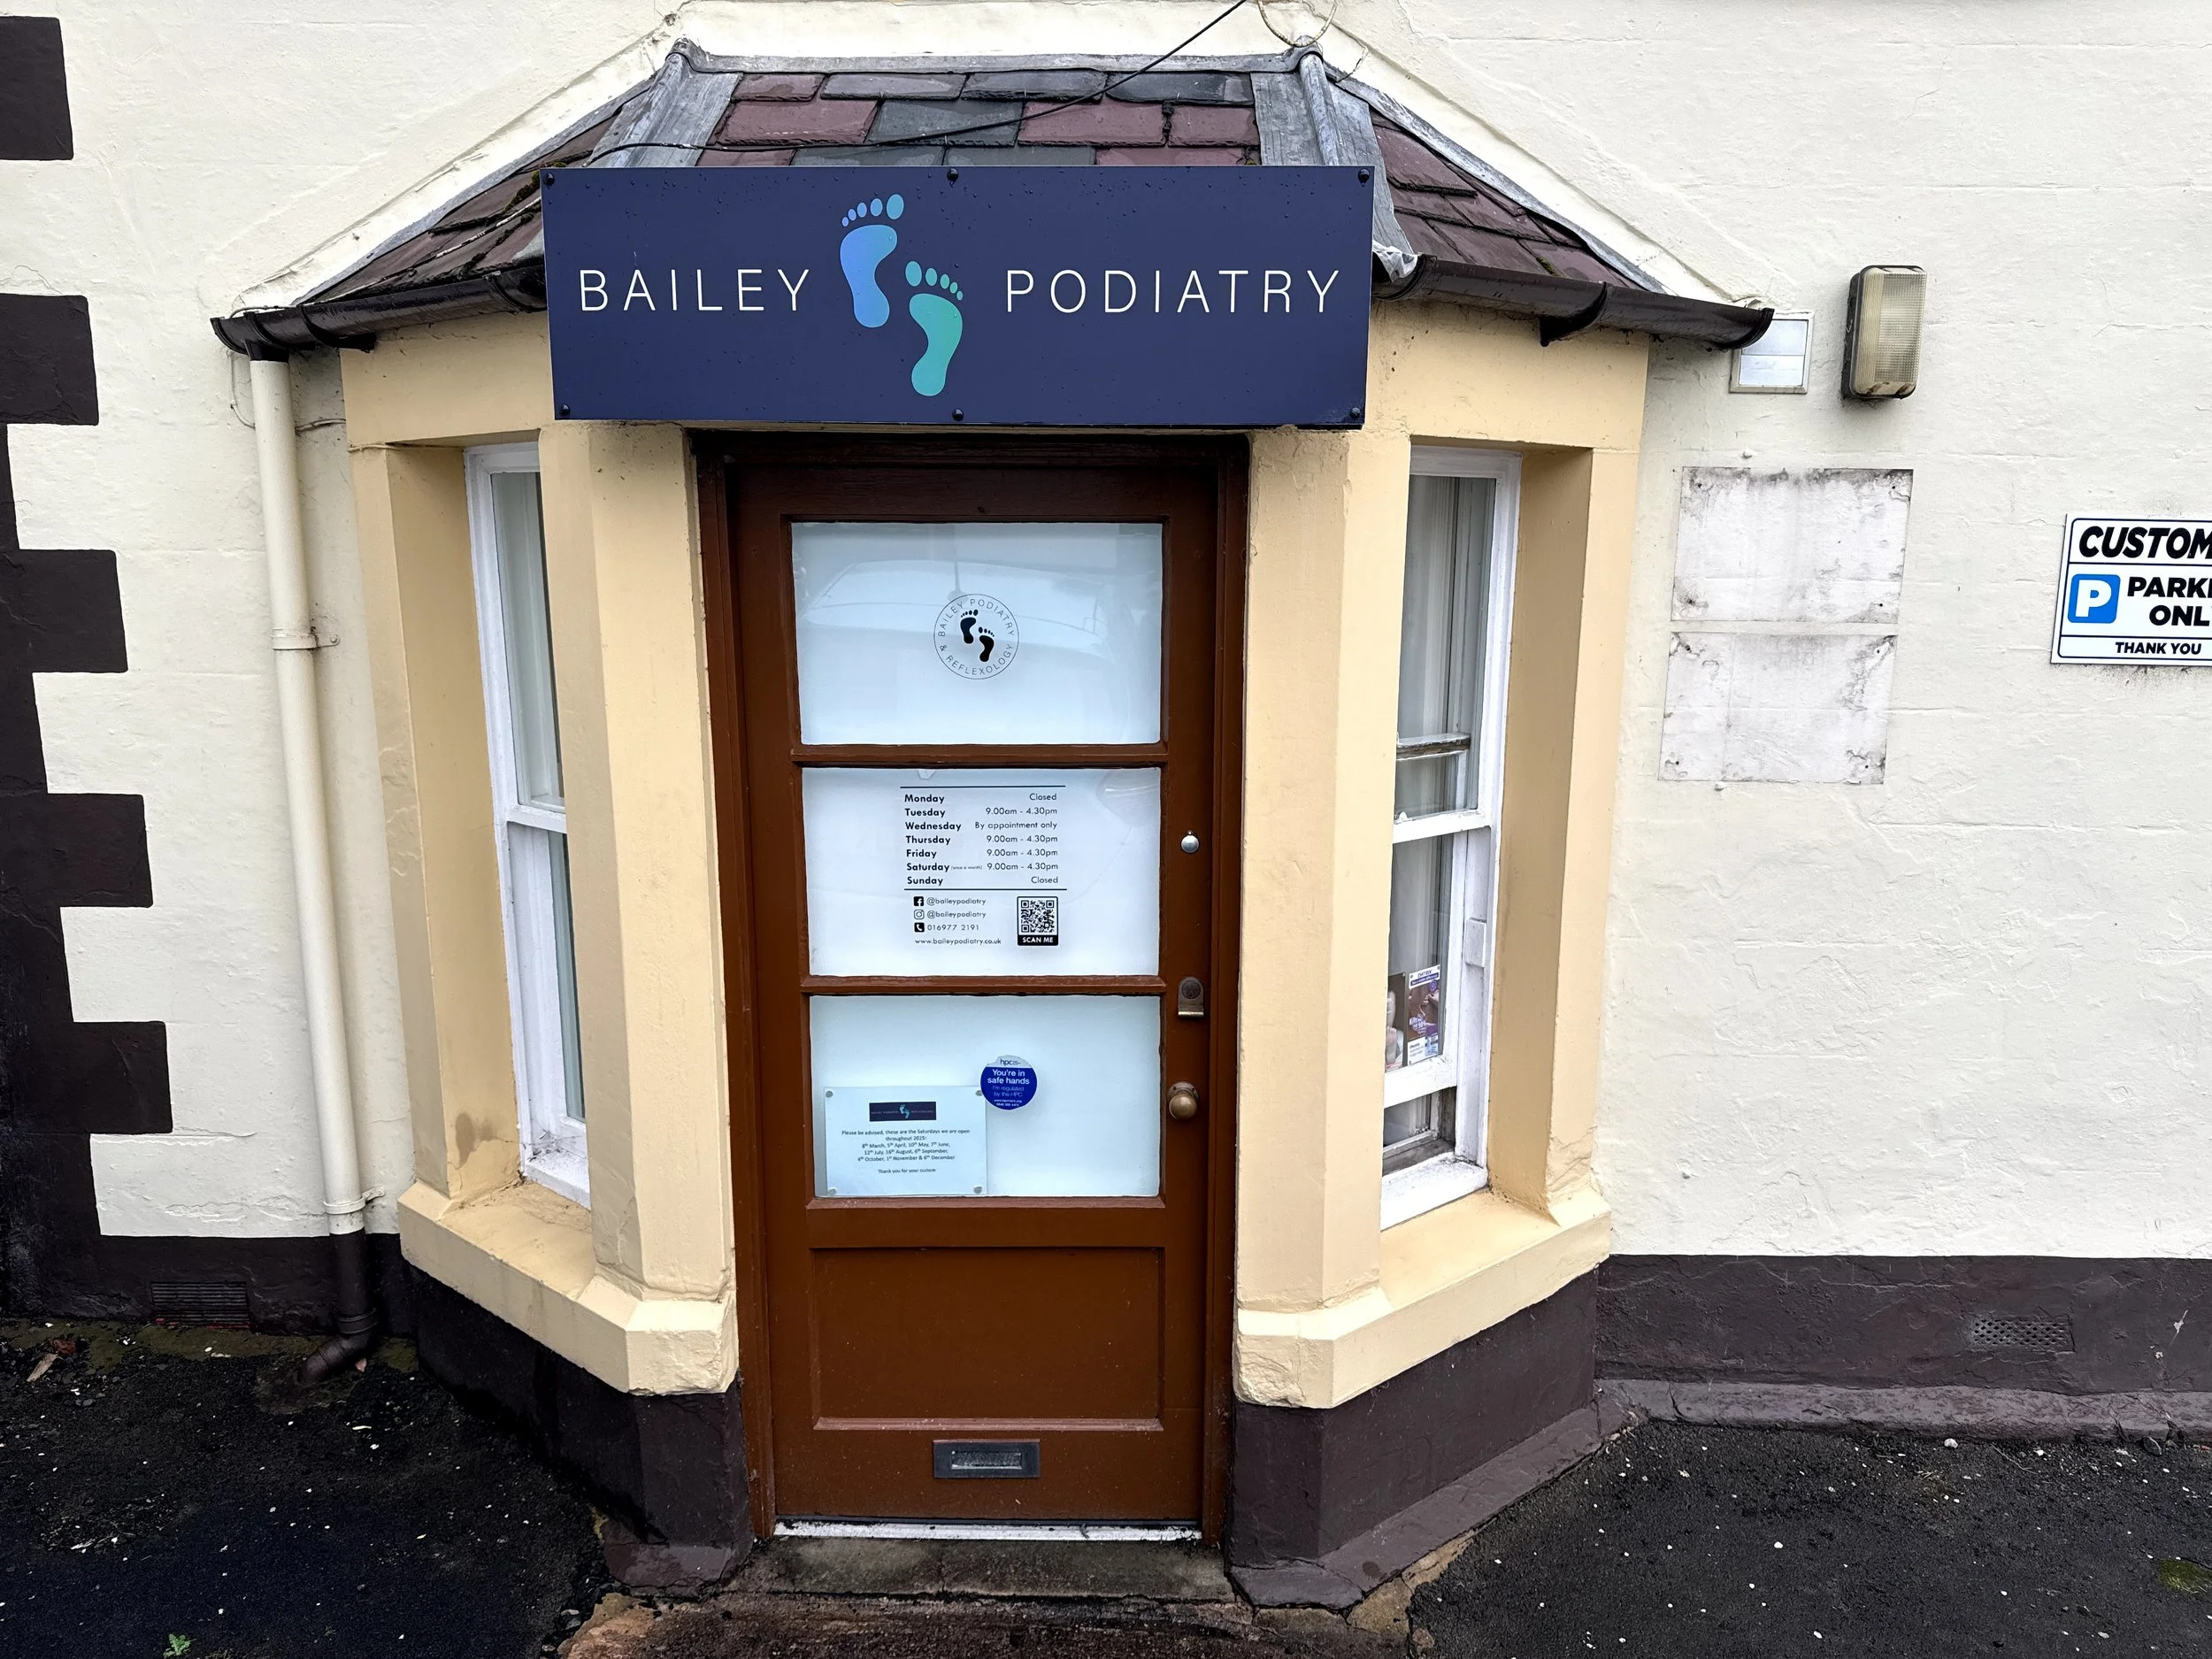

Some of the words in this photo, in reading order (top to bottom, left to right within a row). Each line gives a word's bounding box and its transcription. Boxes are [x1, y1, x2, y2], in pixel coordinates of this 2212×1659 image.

[580, 269, 810, 312] BAILEY
[1007, 270, 1340, 314] PODIATRY
[2079, 526, 2212, 559] CUSTOM
[2076, 580, 2111, 617] P
[938, 602, 964, 636] BAILEY
[970, 599, 1015, 636] PODIATRY
[2149, 604, 2212, 626] ONL
[2116, 642, 2167, 654] THANK
[2170, 643, 2201, 655] YOU
[946, 644, 1013, 675] REFLEXOLOGY
[904, 795, 945, 804] Monday
[905, 808, 946, 818] Tuesday
[1026, 808, 1057, 817] 4.30pm
[905, 822, 962, 832] Wednesday
[1041, 821, 1057, 830] only
[906, 835, 950, 845] Thursday
[1026, 835, 1058, 844] 4.30pm
[906, 849, 937, 859] Friday
[1027, 849, 1058, 858] 4.30pm
[907, 863, 950, 872] Saturday
[1027, 863, 1058, 872] 4.30pm
[907, 876, 943, 886] Sunday
